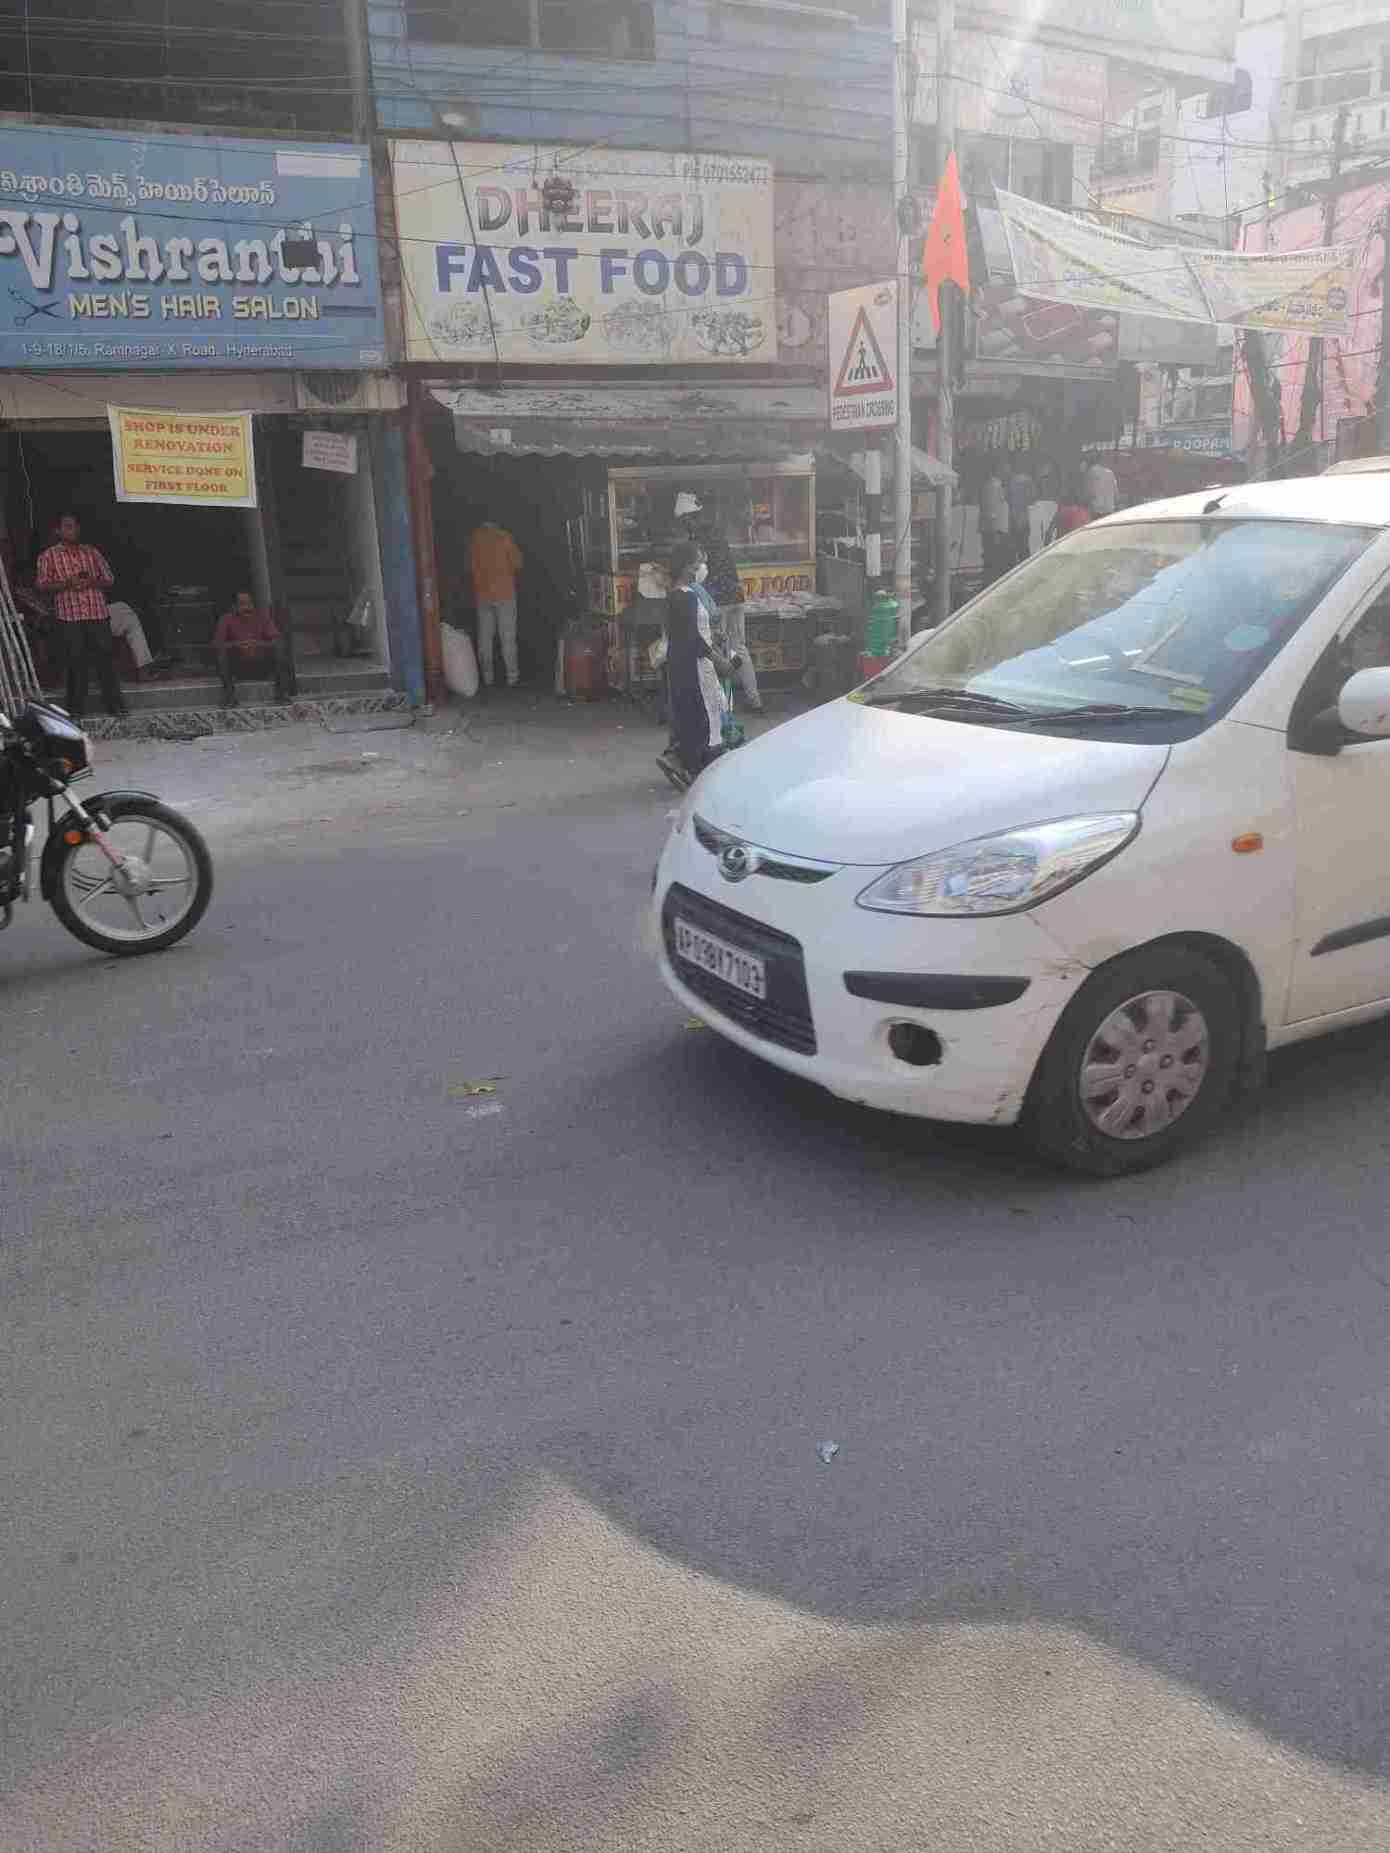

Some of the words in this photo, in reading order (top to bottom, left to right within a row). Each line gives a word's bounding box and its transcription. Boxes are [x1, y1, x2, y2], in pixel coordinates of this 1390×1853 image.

[435, 245, 577, 294] FAST
[601, 248, 748, 297] FOOD
[67, 291, 152, 319] MEN'S
[161, 294, 222, 320] HAIR
[232, 296, 320, 320] SALON
[125, 419, 165, 433] SHOP
[169, 423, 183, 433] IS
[187, 423, 240, 438] UNDER
[134, 438, 233, 453] RENOVATION
[127, 463, 182, 475] SERVICE
[186, 465, 224, 477] DONE
[225, 466, 243, 479] ON
[144, 480, 184, 492] FIRST
[186, 482, 228, 493] FLOOR
